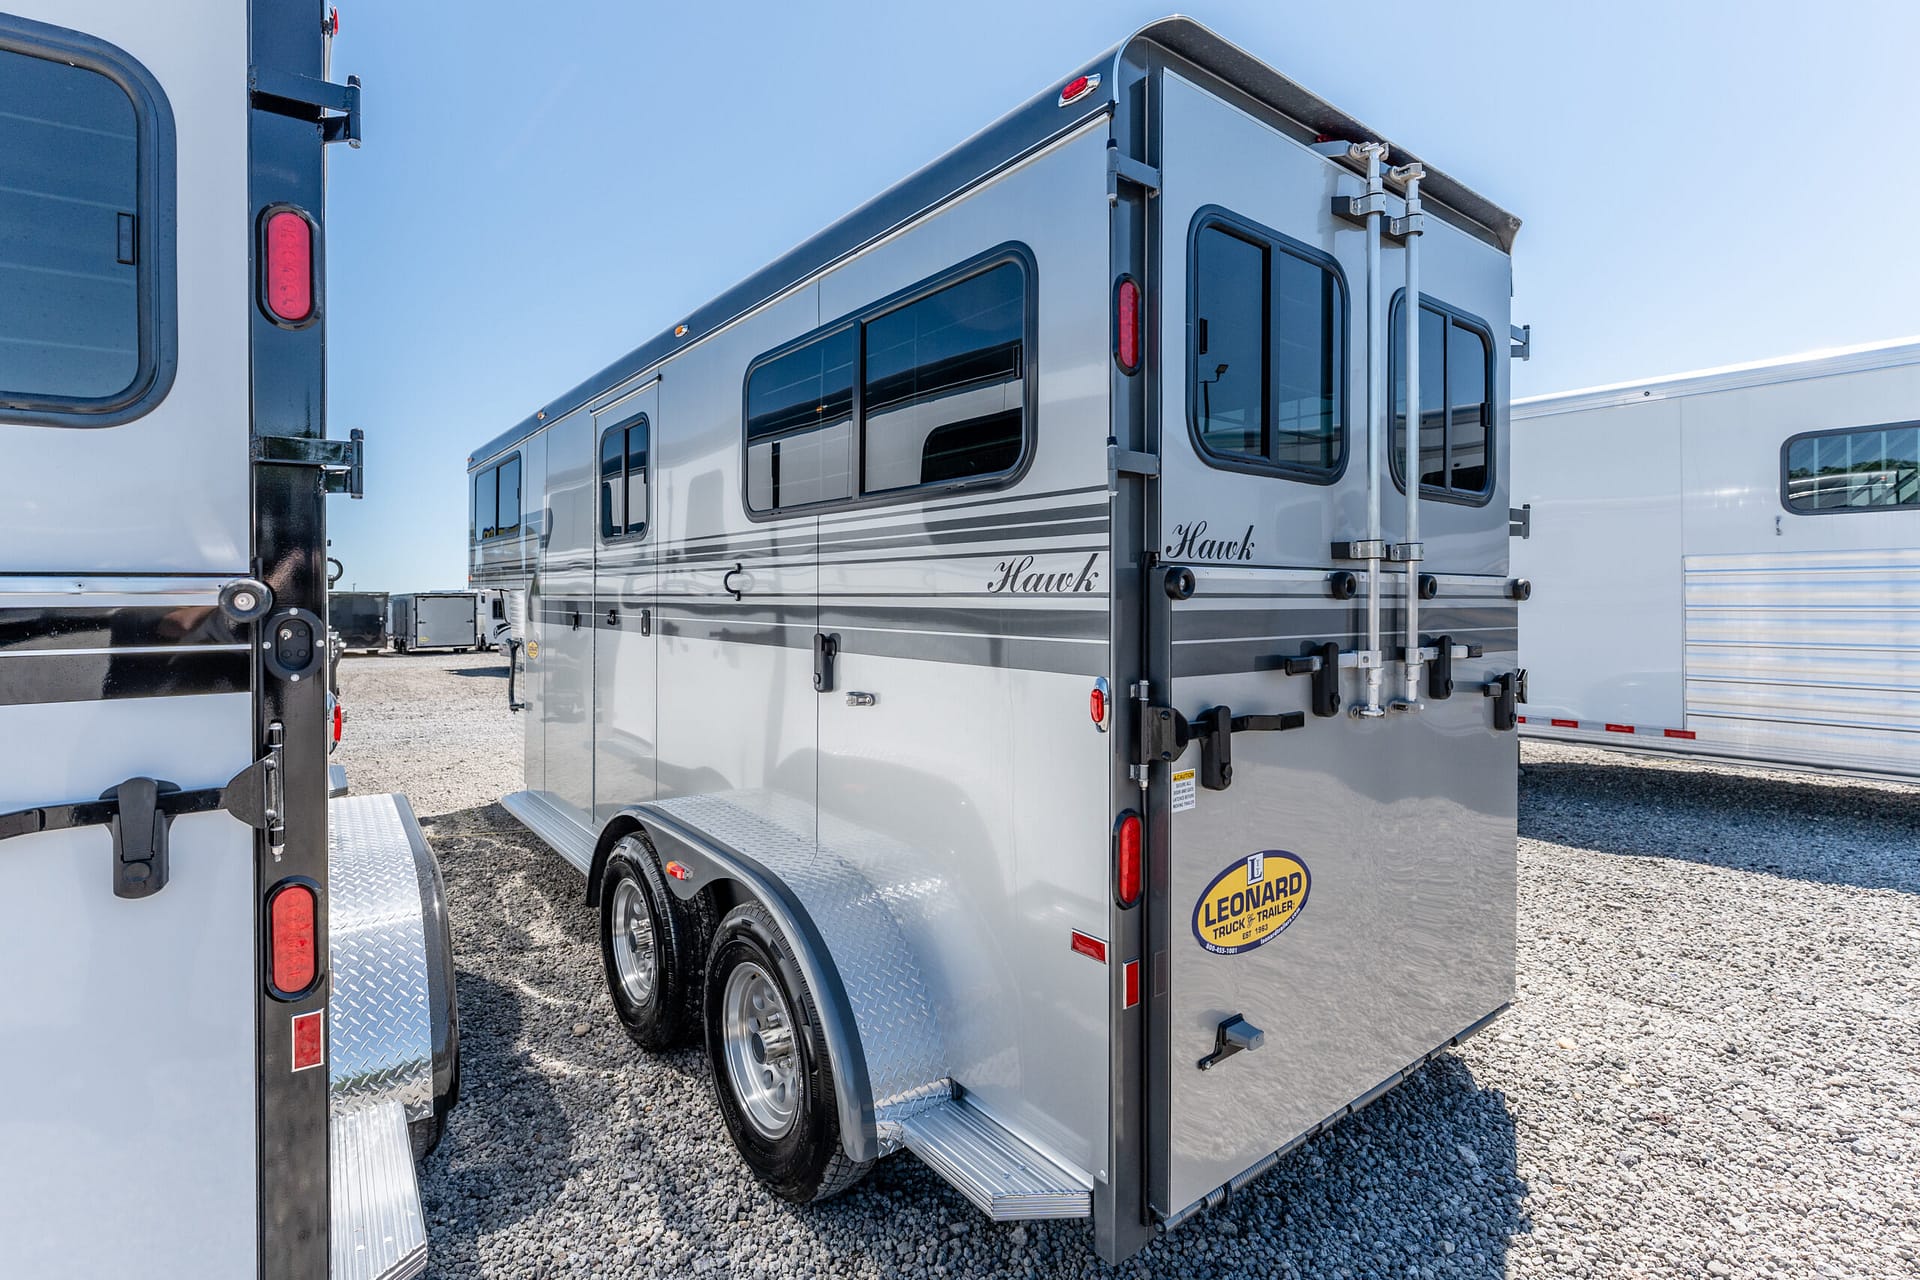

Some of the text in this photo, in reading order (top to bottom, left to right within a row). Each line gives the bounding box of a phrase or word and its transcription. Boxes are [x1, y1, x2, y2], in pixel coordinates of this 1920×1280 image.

[1166, 520, 1255, 560] Hawk
[987, 552, 1100, 594] Hawk
[1205, 871, 1302, 927] LEONARD
[1213, 918, 1245, 940] TRUCK
[1257, 900, 1293, 922] TRAILER
[1242, 930, 1252, 940] EST
